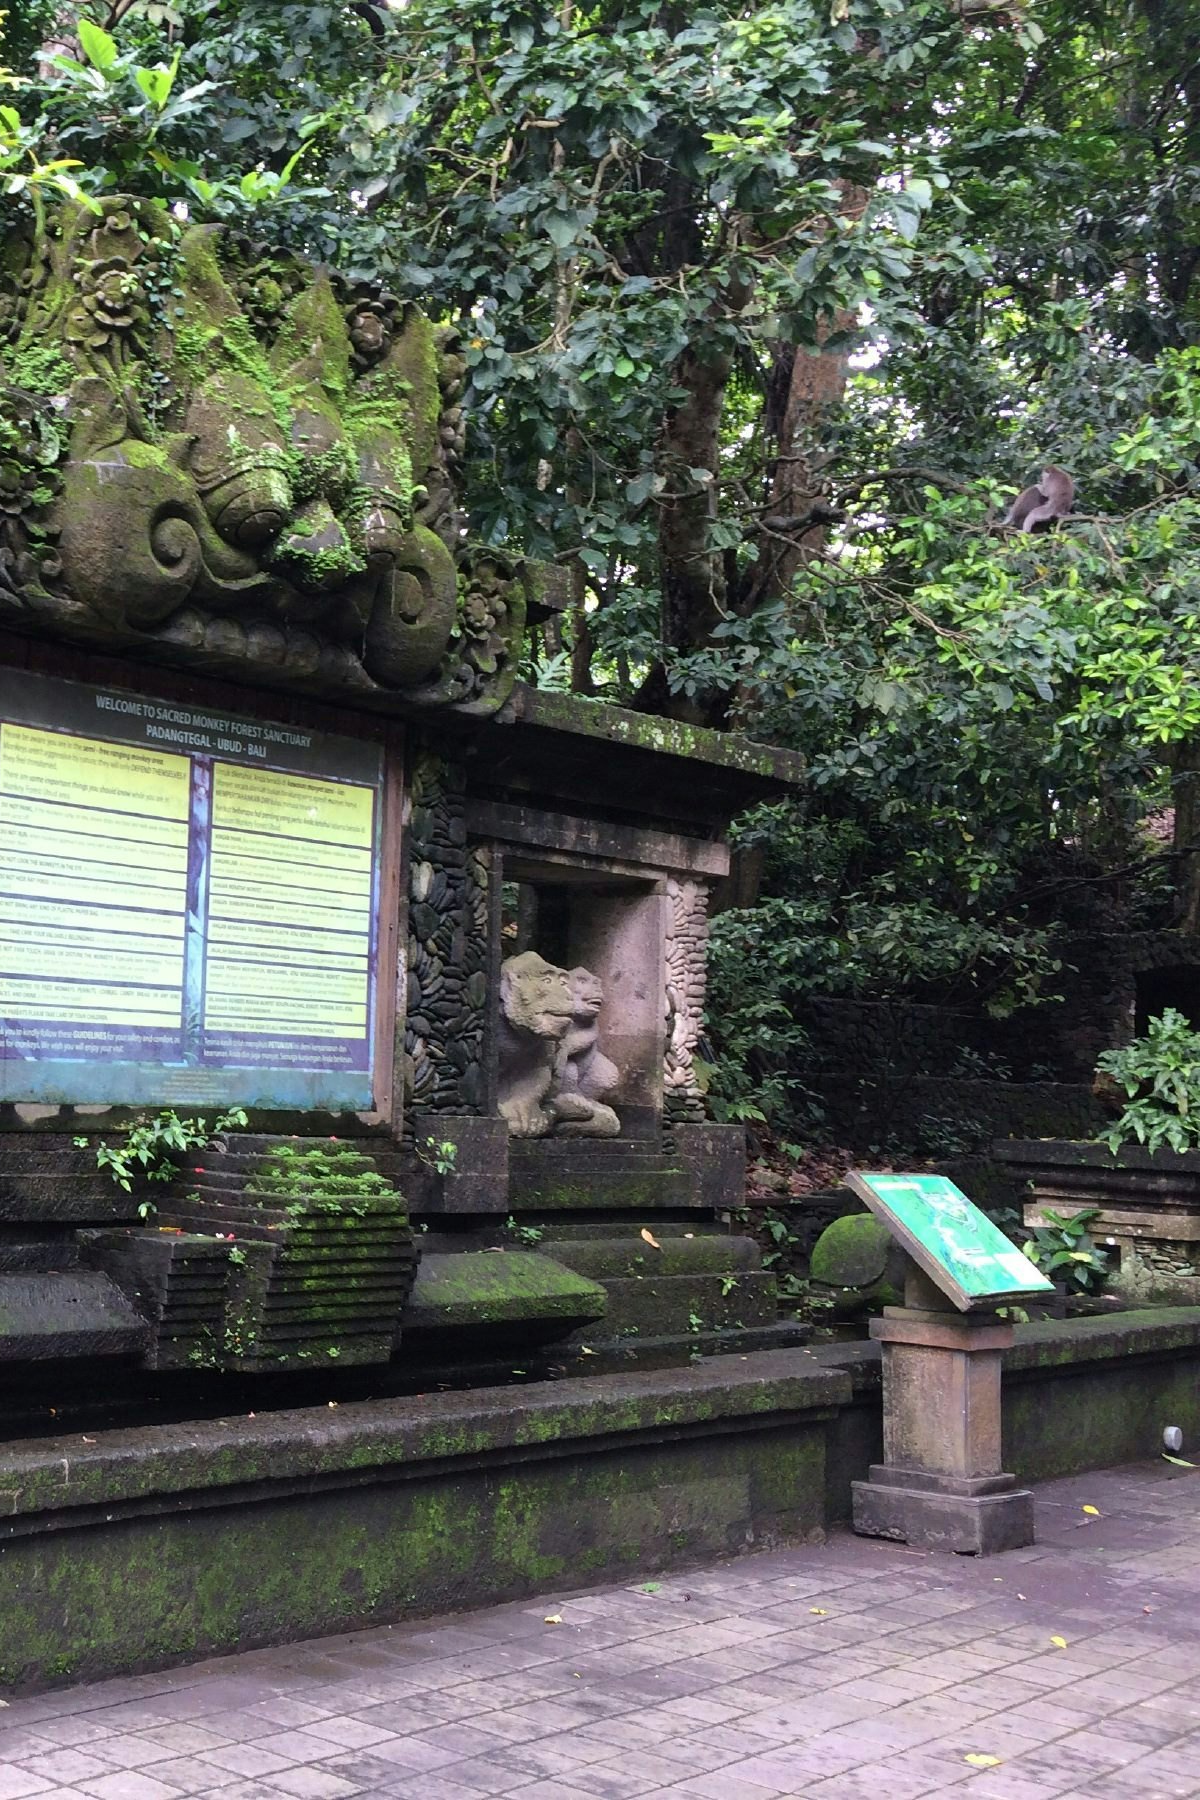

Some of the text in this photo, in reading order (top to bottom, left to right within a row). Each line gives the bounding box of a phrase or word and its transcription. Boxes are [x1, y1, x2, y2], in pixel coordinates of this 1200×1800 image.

[95, 695, 312, 749] WELCOME TO SACRED MONKEY FOREST SANCTUARY
[146, 724, 212, 749] PADANGTEGAL
[217, 737, 242, 755] UBUD
[247, 743, 267, 759] BALI
[73, 1030, 107, 1040] GUIDELINES
